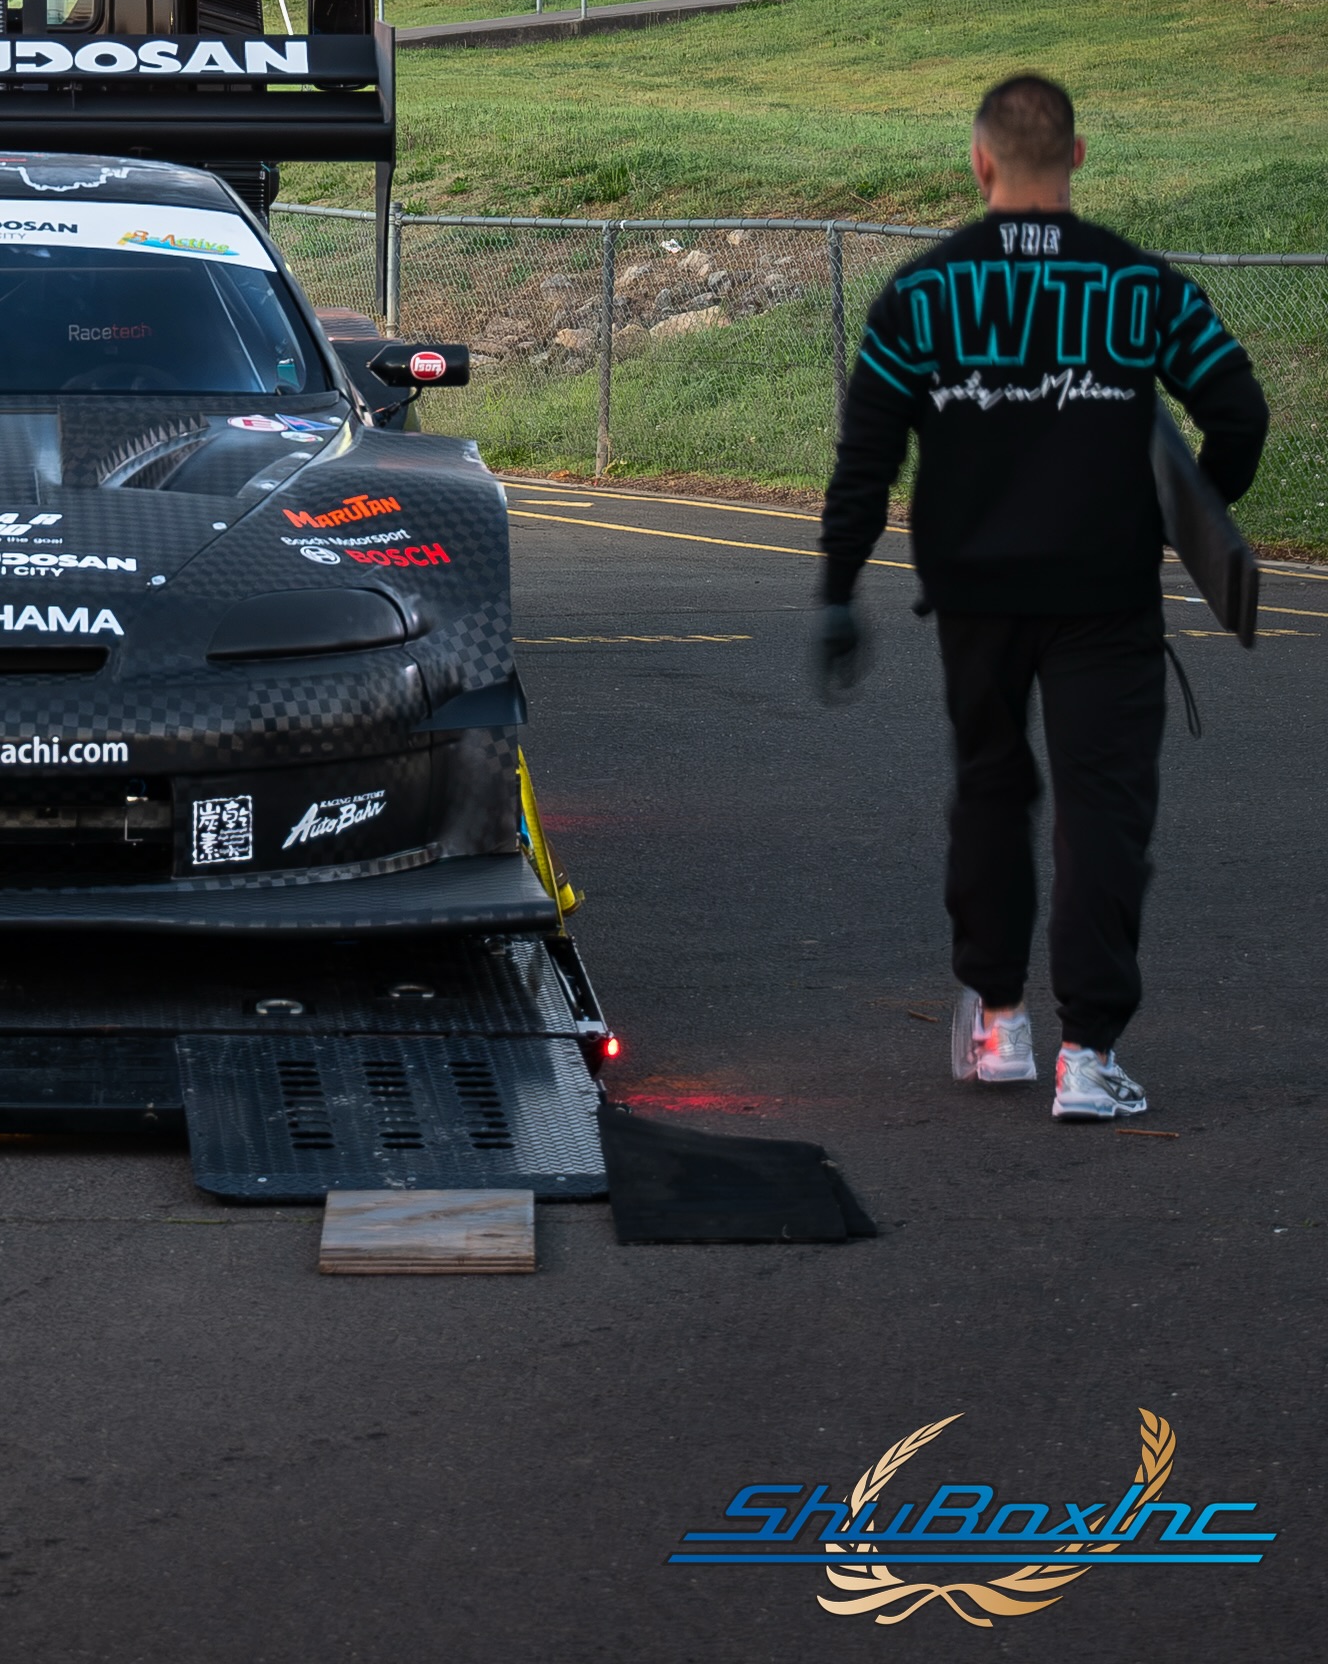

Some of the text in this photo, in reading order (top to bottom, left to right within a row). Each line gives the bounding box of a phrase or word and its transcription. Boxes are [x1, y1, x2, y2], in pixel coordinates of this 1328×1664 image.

[68, 322, 153, 341] Racetech
[329, 528, 412, 548] Motorsport
[344, 543, 452, 567] BOSCH
[13, 566, 65, 577] CITY
